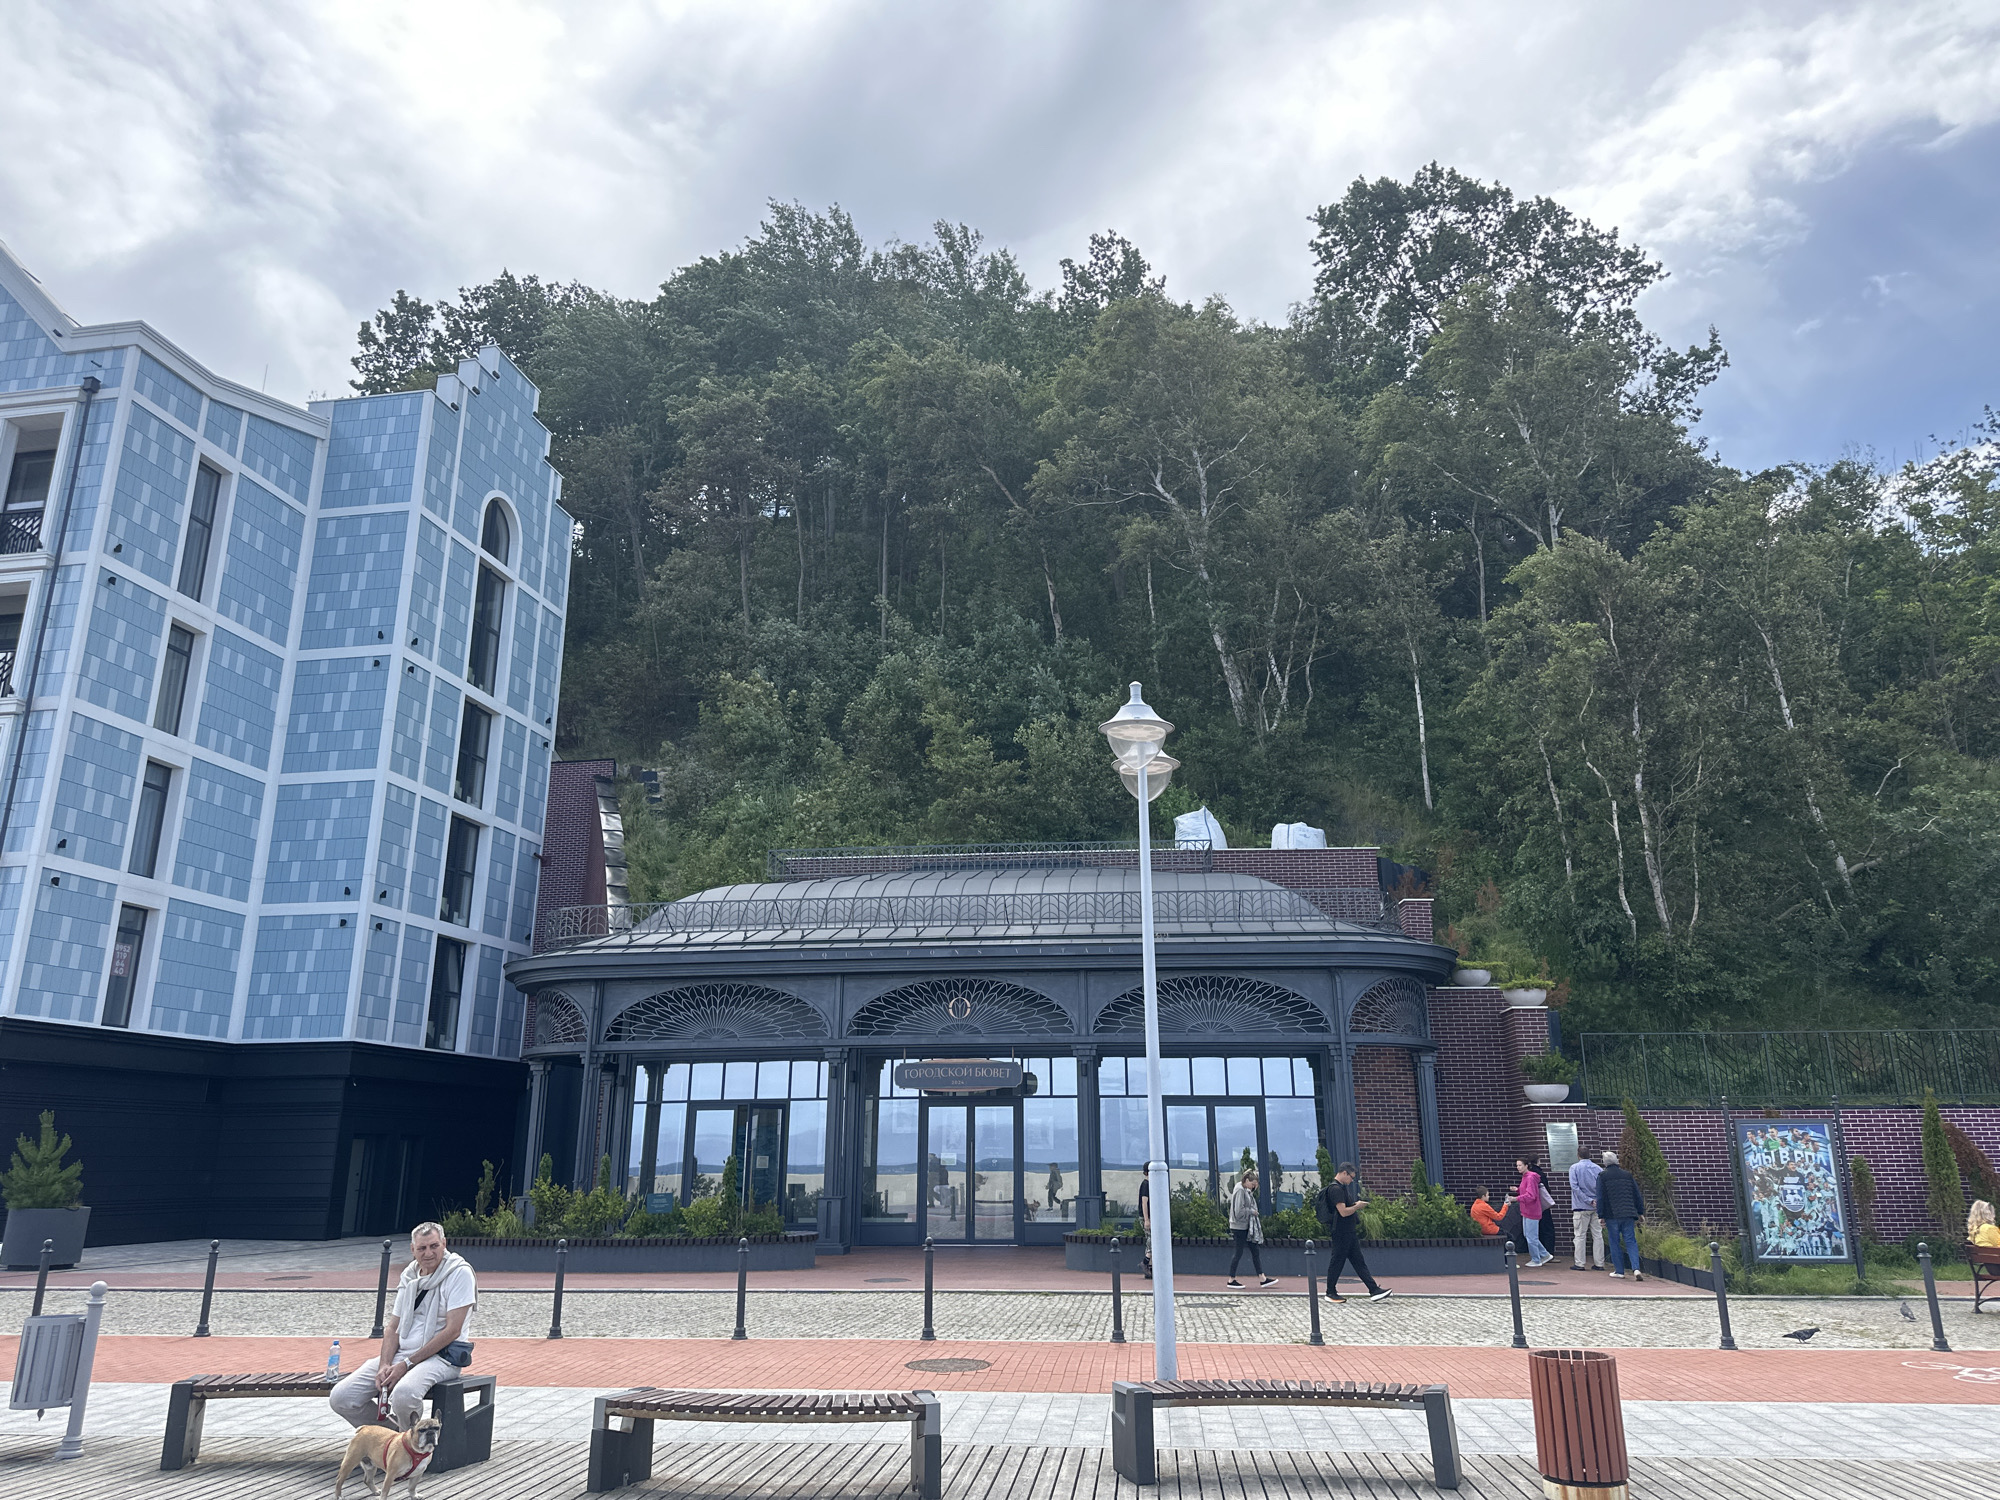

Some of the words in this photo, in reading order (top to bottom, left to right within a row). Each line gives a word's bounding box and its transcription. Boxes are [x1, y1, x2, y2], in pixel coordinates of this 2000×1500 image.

[116, 951, 128, 959] 119
[904, 1065, 973, 1080] ГОРОДСКОЙ
[974, 1067, 1012, 1079] БЮВЕТ
[1749, 1150, 1776, 1168] МЫ
[1780, 1149, 1791, 1165] В
[1793, 1149, 1828, 1166] РПЛ
